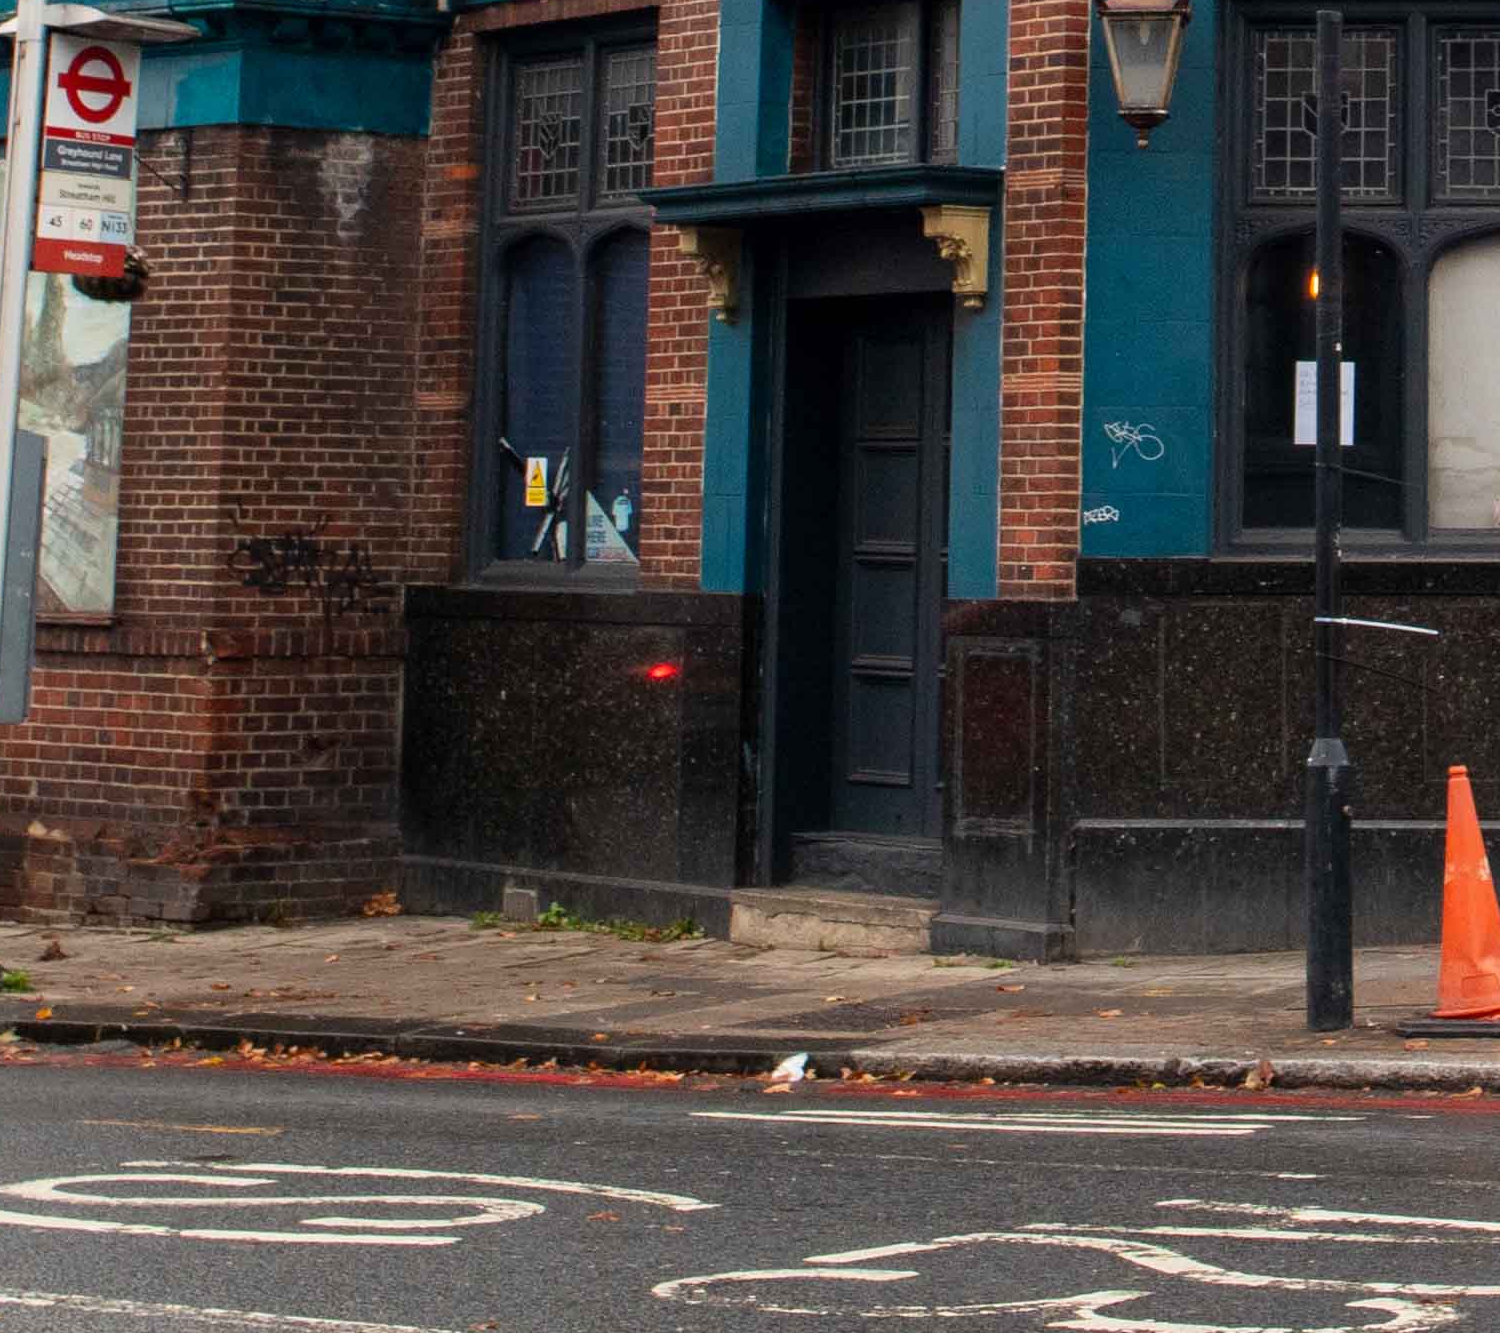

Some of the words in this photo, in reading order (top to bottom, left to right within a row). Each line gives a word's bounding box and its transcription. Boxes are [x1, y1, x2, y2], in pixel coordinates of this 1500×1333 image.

[57, 144, 103, 159] Greyhound
[105, 149, 123, 162] Lane
[59, 188, 100, 201] Streatham
[101, 219, 127, 234] N133
